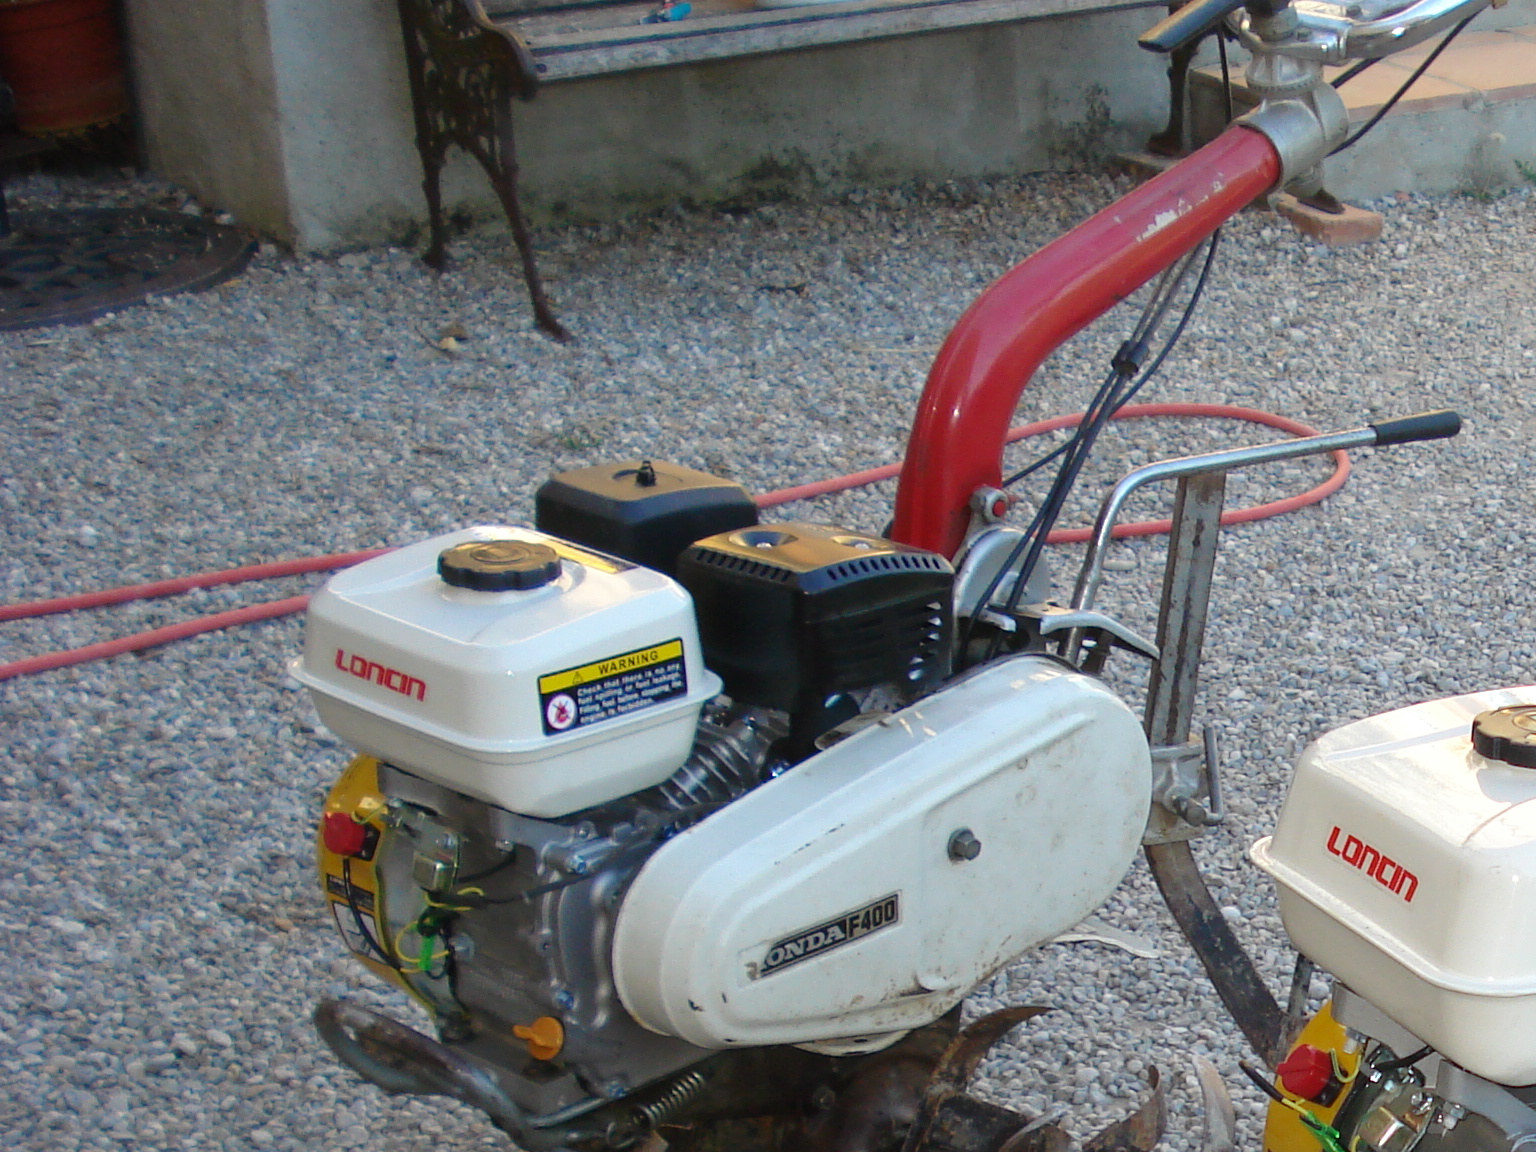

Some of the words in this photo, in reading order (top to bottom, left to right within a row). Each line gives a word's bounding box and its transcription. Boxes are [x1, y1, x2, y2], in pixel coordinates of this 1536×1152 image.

[335, 648, 426, 702] LONCIN
[598, 650, 659, 674] WARNING
[1326, 826, 1419, 903] LONCIN
[759, 925, 845, 970] ONDA
[848, 899, 895, 937] F400
